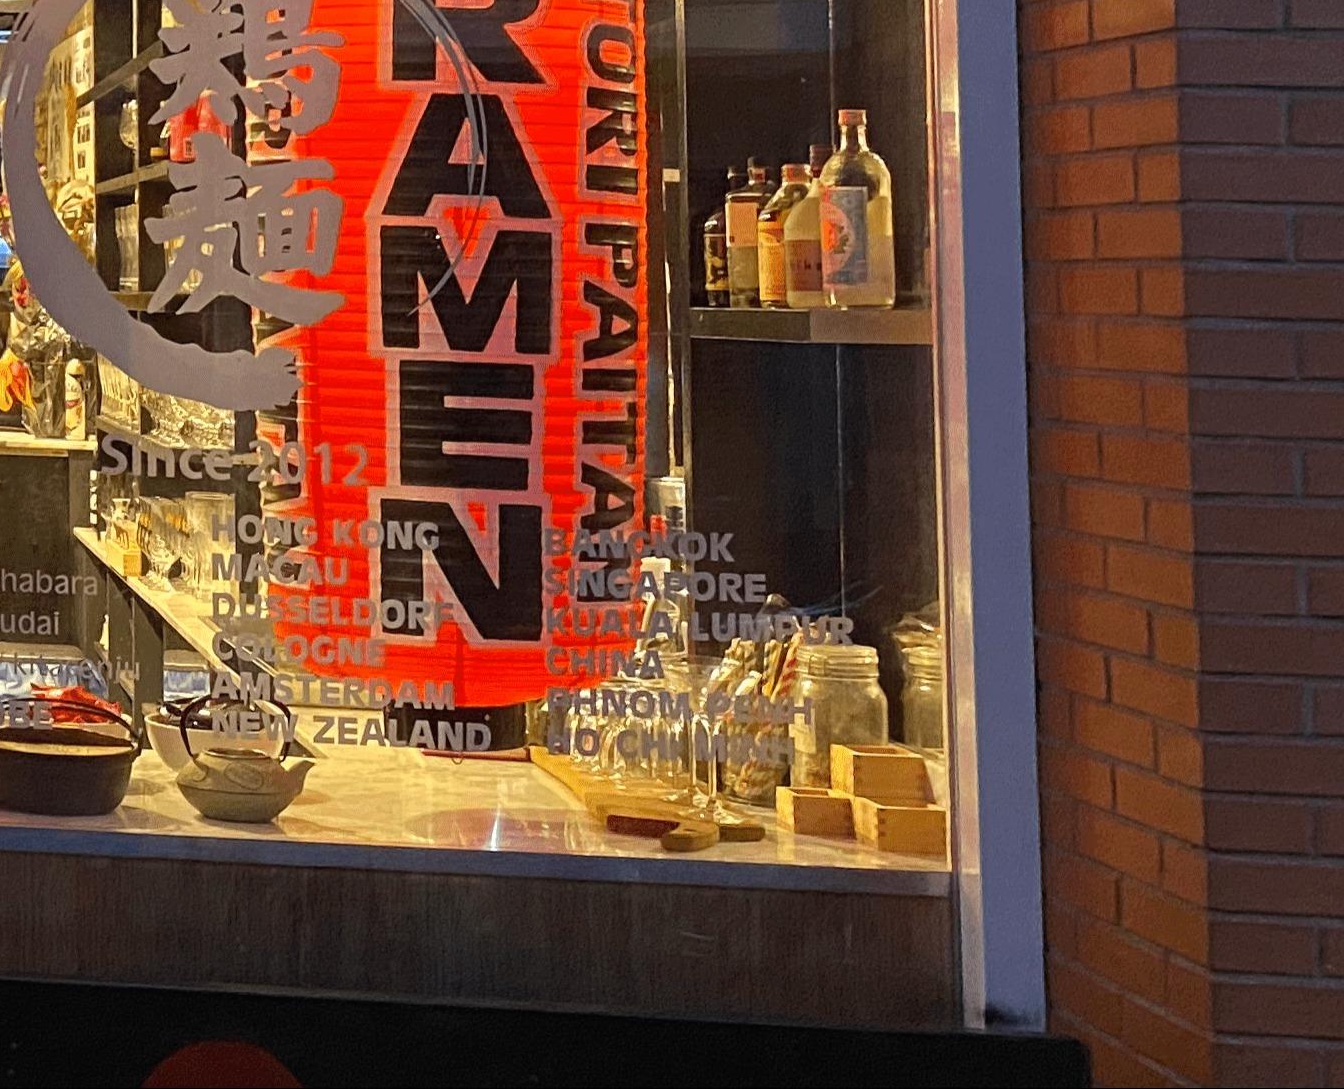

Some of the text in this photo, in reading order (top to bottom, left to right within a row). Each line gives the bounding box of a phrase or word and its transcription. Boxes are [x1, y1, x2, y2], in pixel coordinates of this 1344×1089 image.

[579, 221, 640, 603] PAITAN
[100, 432, 371, 487] Since 2012
[212, 513, 440, 551] HONG KONG
[545, 528, 735, 563] BANGKOK
[212, 552, 349, 586] MACAU
[544, 569, 767, 604] SINGAPORE
[545, 608, 855, 646] KUALA LUMPUR
[212, 631, 386, 667] COLOGNE
[545, 647, 665, 679] CHINA
[212, 671, 456, 711] AMSTERDAM
[546, 687, 693, 721] PHNOM
[212, 710, 493, 752] NEW ZEALAND
